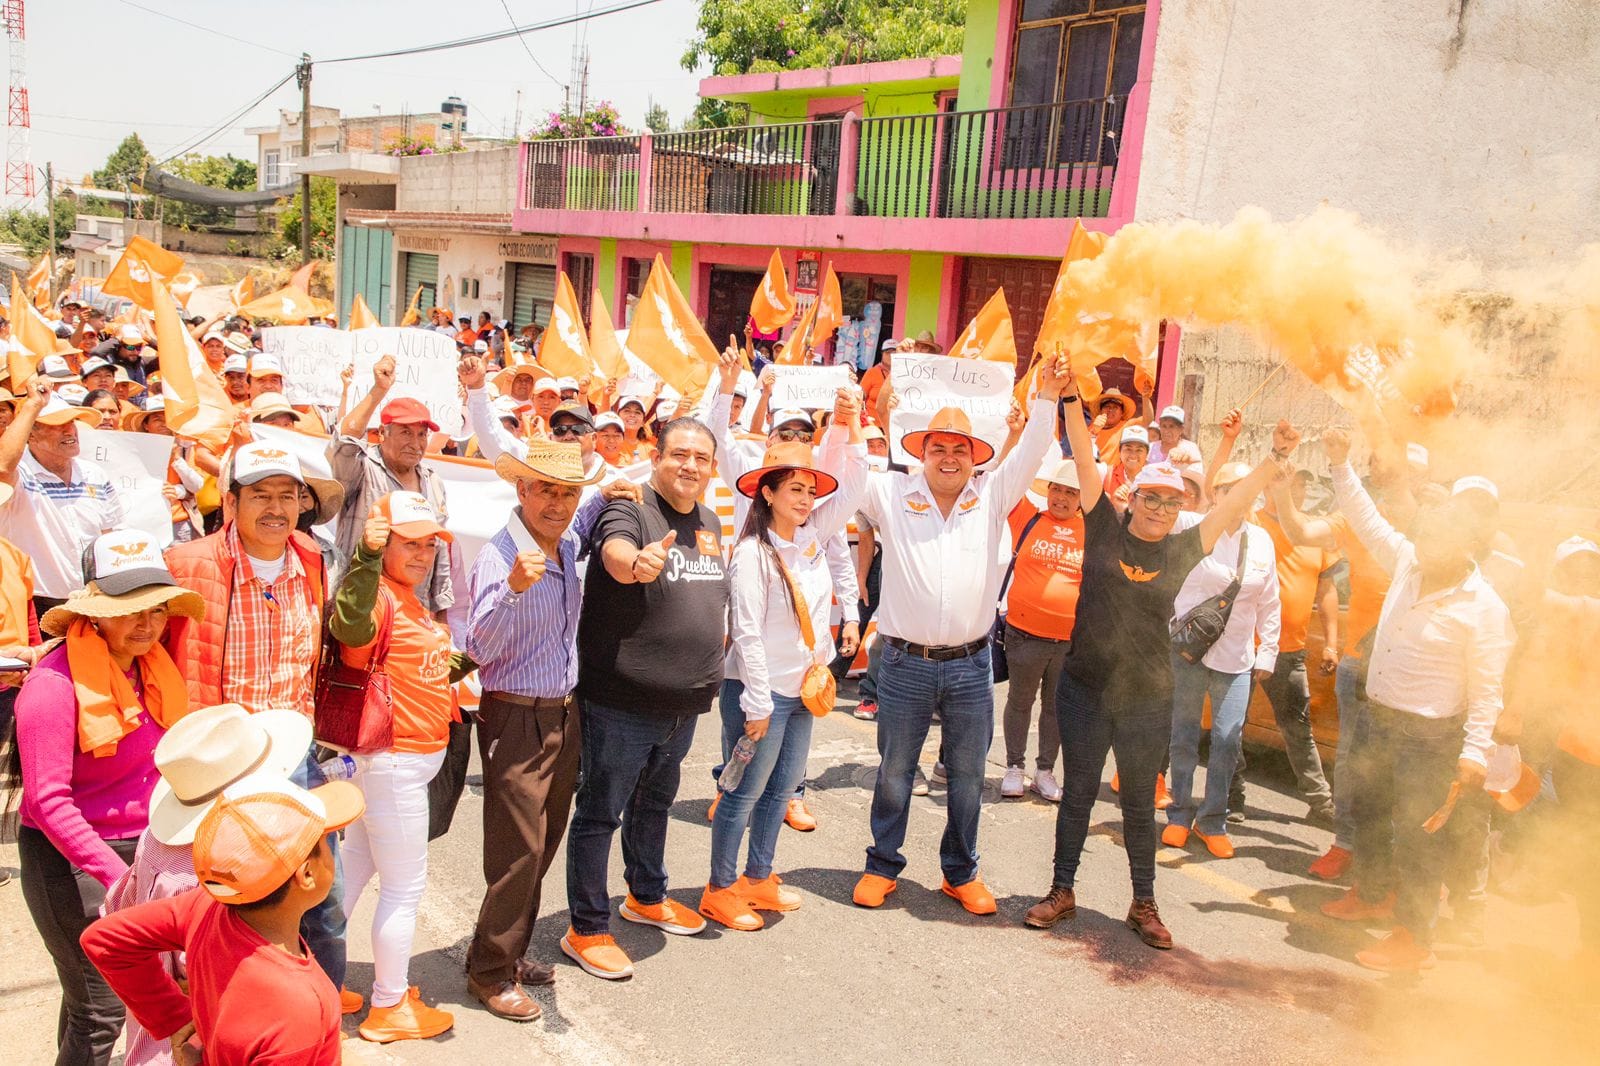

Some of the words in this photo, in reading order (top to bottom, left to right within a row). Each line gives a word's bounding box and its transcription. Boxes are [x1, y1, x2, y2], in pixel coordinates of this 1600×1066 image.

[354, 334, 380, 354] LO
[893, 357, 938, 381] JOSE
[952, 361, 990, 389] LUIS
[667, 548, 724, 582] Puebla
